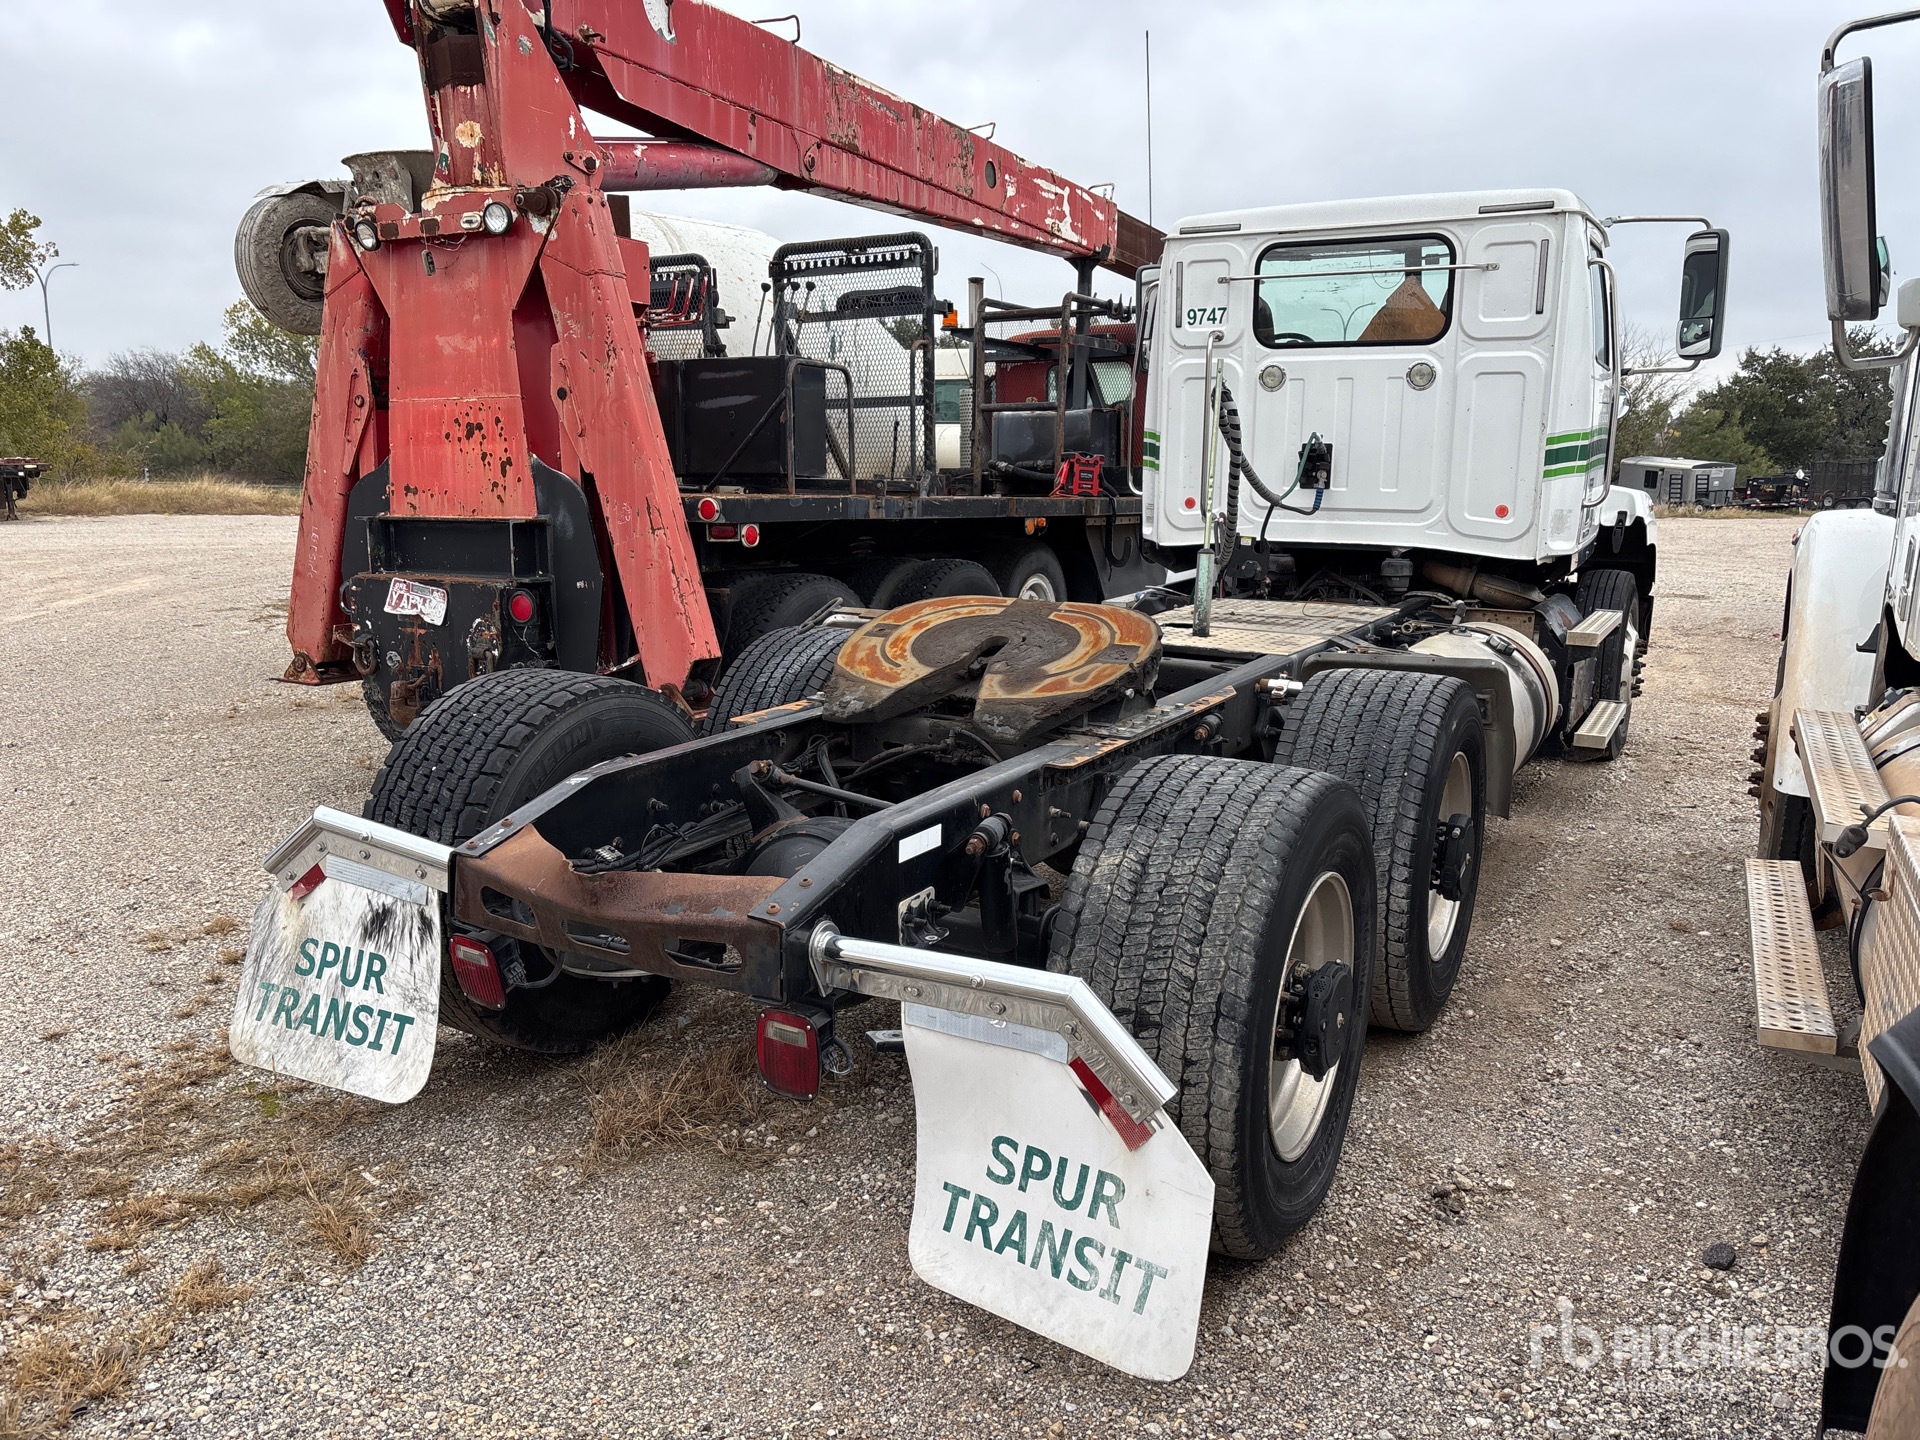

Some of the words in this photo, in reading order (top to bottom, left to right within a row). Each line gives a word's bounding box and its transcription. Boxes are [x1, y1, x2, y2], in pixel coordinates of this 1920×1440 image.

[1187, 307, 1228, 326] 9747
[294, 937, 387, 995] SPUR
[255, 981, 415, 1056] TRANSIT
[985, 1135, 1126, 1230] SPUR
[942, 1181, 1169, 1316] TRANSIT
